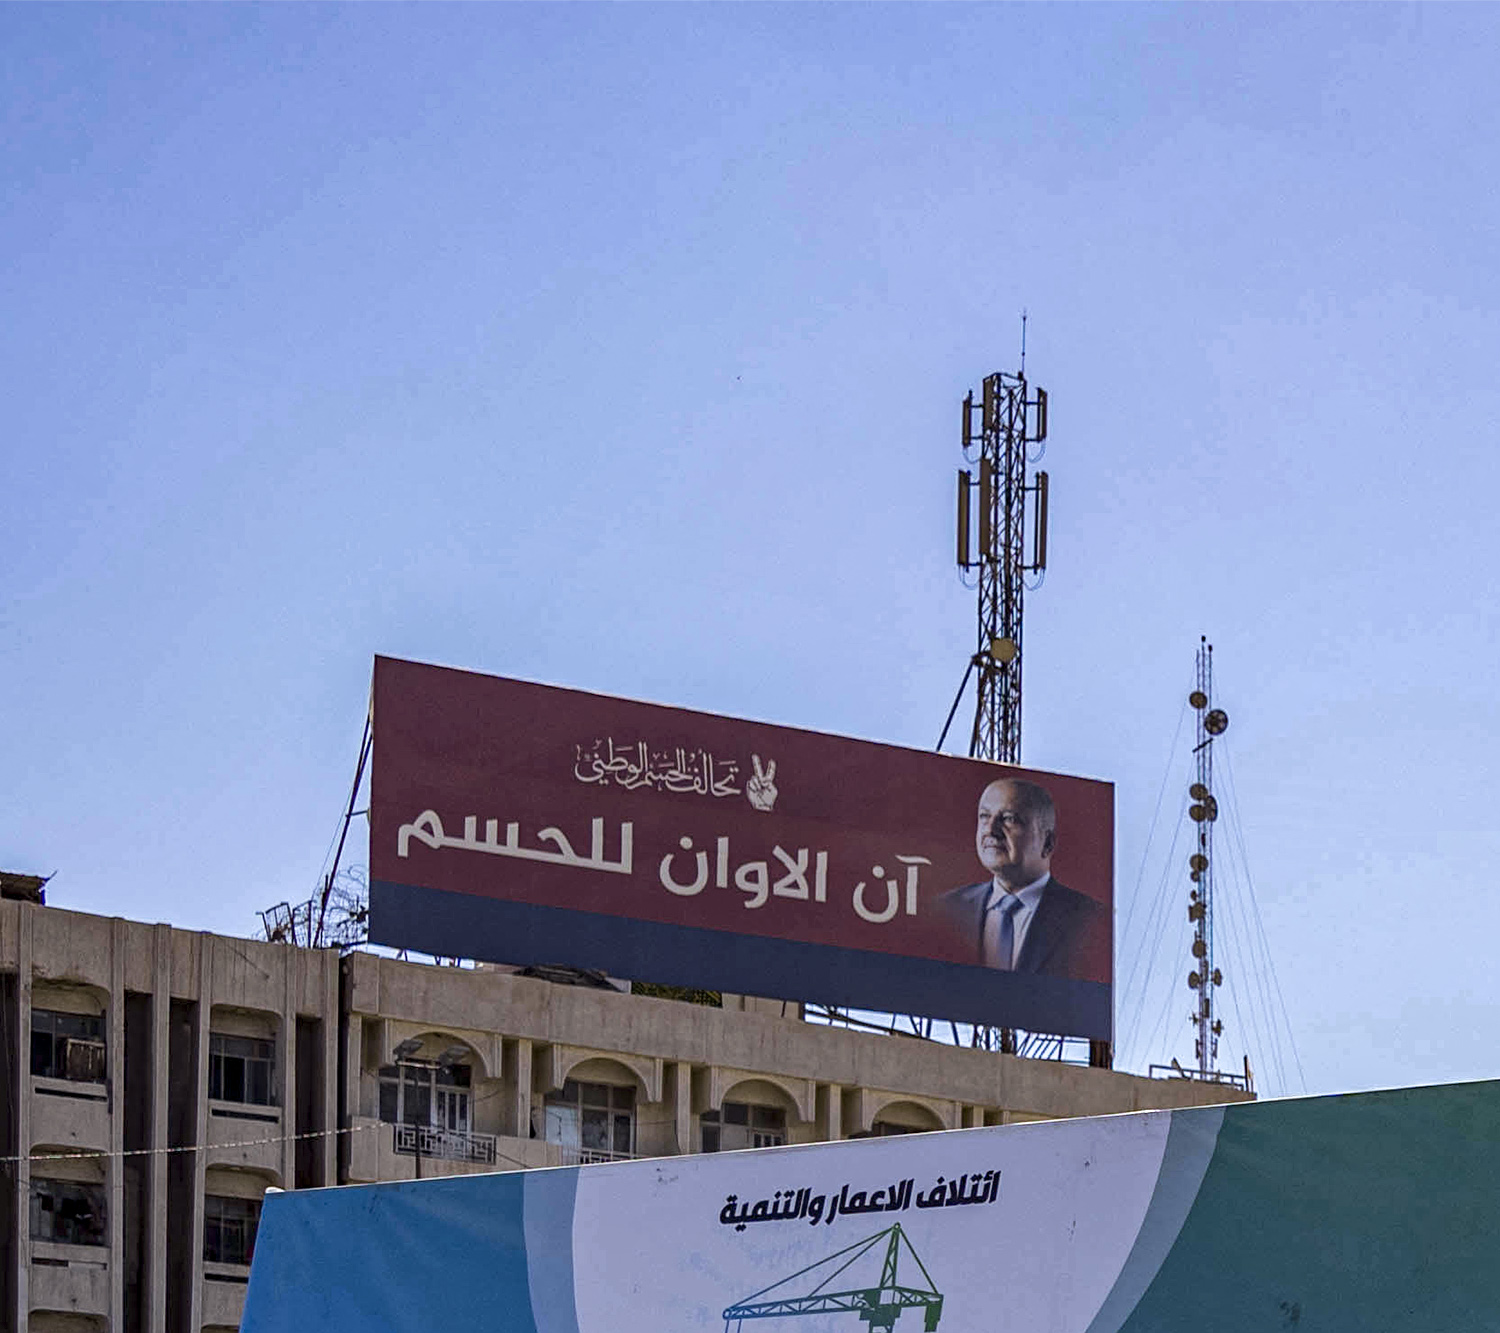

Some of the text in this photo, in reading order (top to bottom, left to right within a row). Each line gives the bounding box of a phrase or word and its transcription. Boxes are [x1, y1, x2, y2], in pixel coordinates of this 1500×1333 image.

[398, 810, 931, 922] آن الاوان للحسم
[720, 1170, 1001, 1231] ائتلاف الاعمار والتنمية
